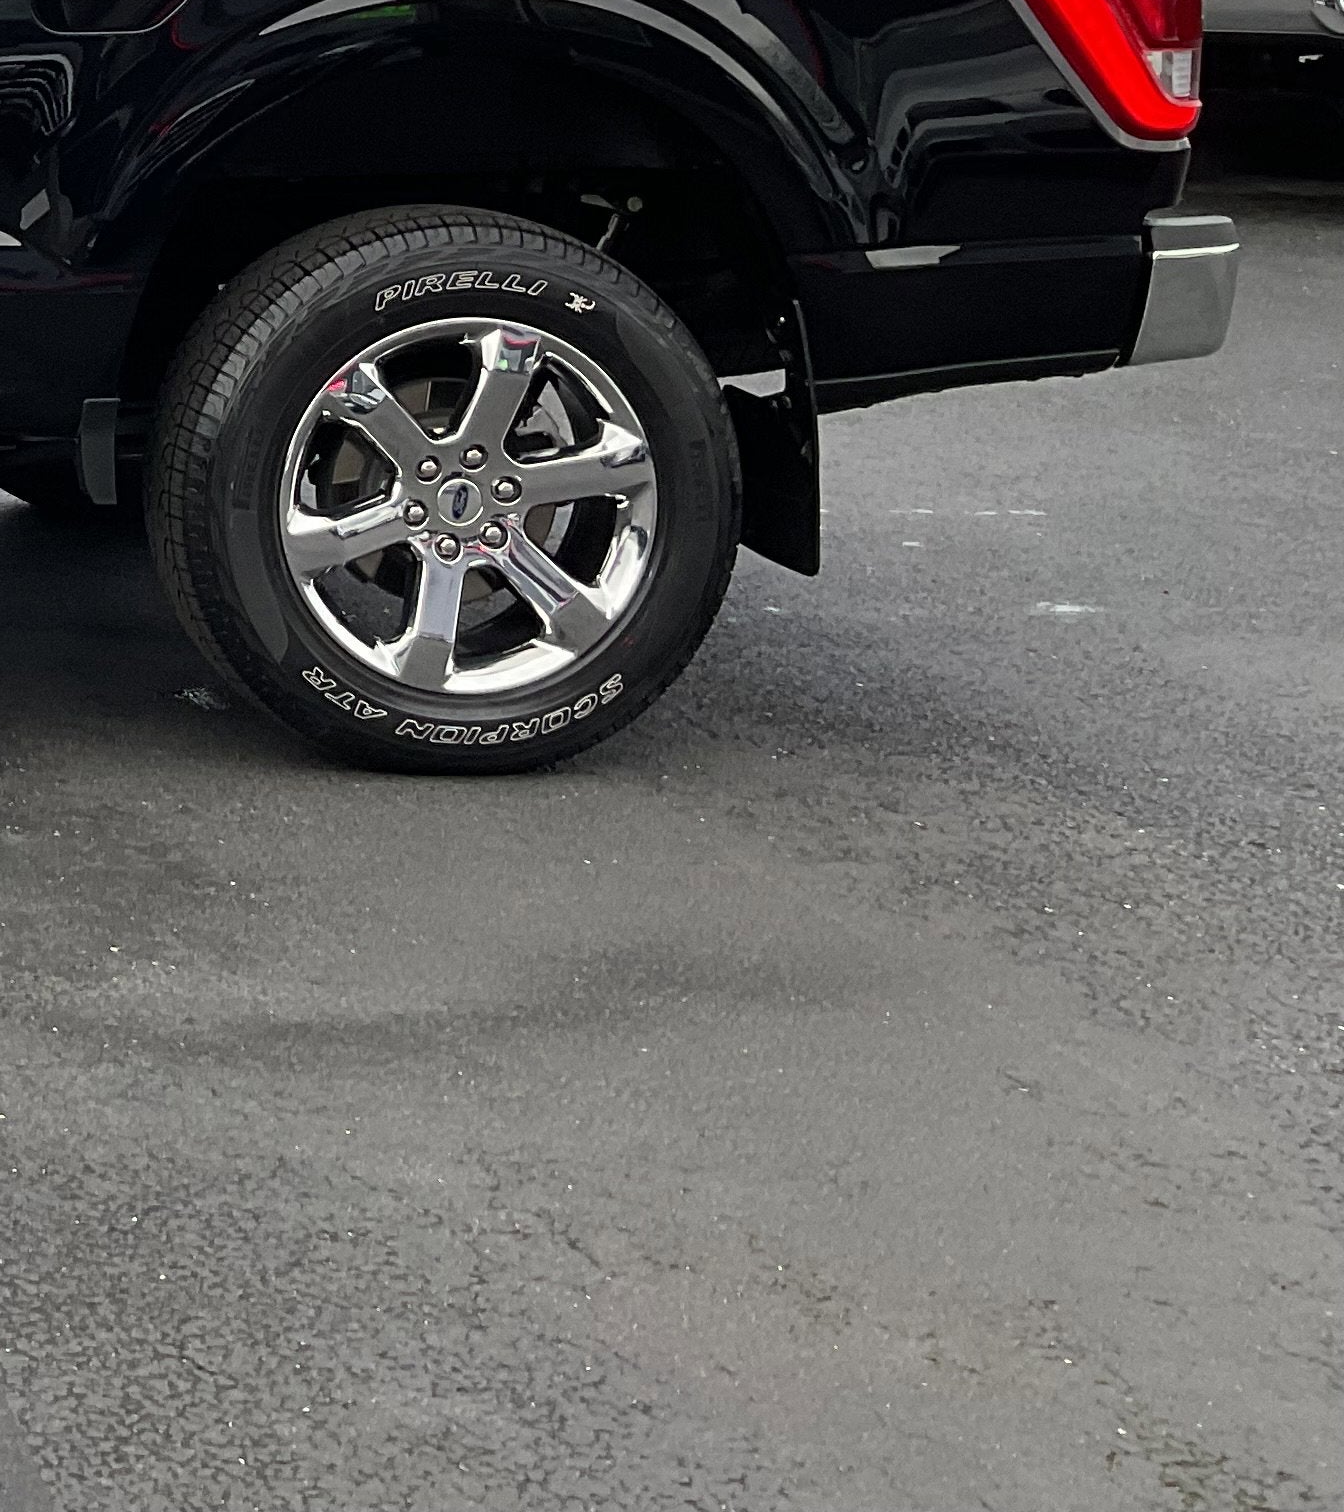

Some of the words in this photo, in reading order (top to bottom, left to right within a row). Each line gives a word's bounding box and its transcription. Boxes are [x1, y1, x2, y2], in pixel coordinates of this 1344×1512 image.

[374, 270, 549, 311] PIRELLI
[301, 666, 388, 719] ATR
[395, 674, 624, 745] SCORPION
